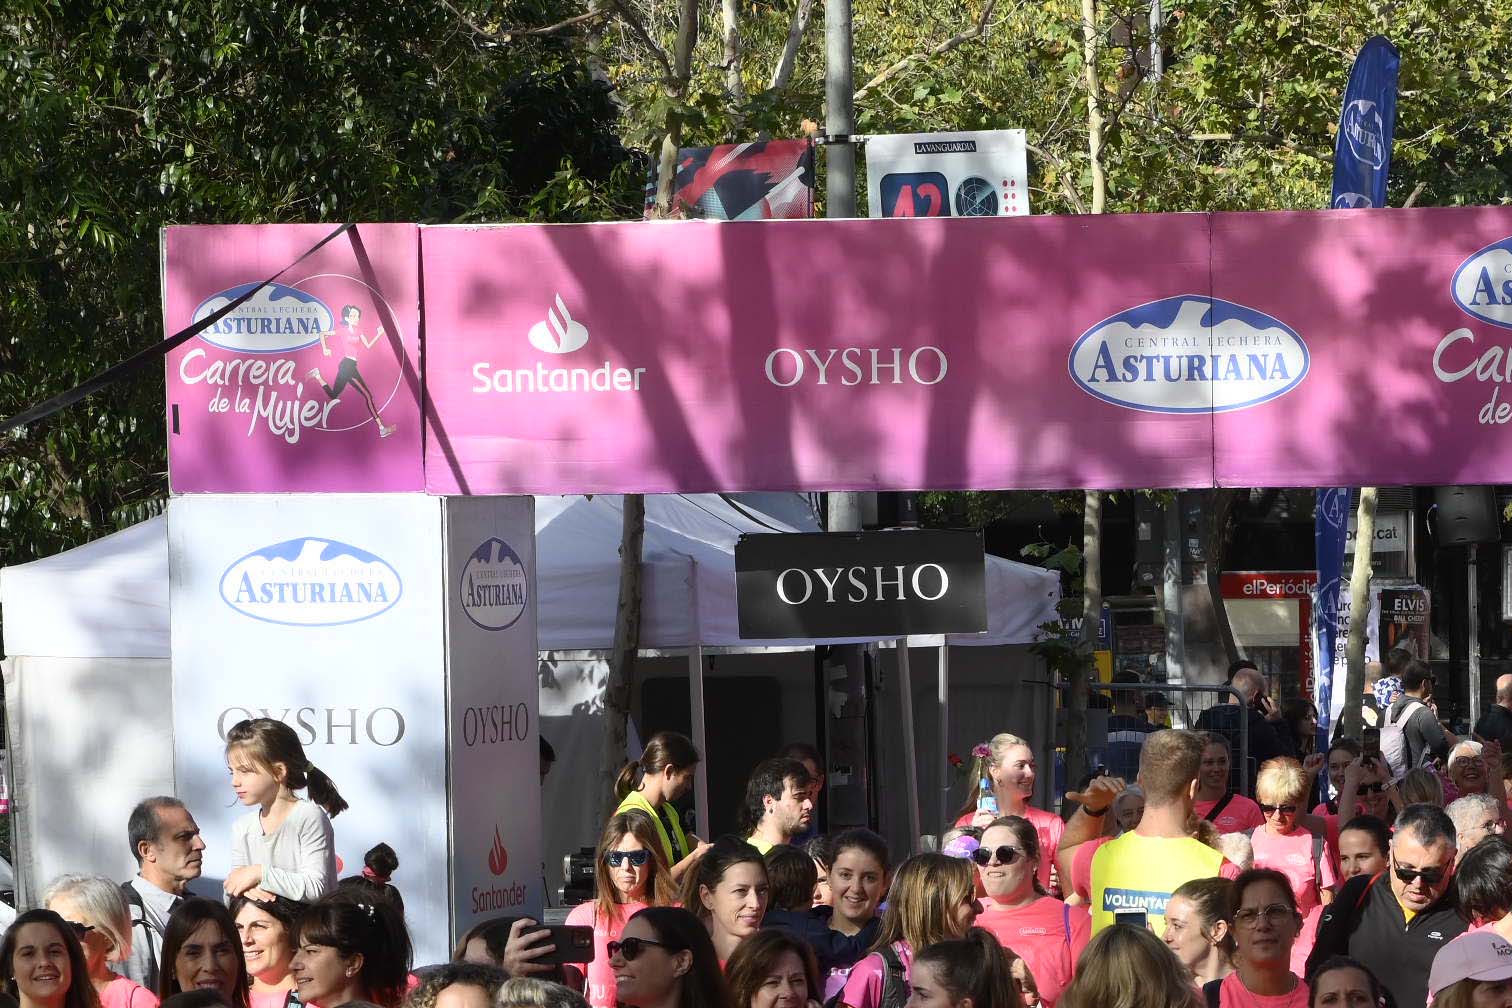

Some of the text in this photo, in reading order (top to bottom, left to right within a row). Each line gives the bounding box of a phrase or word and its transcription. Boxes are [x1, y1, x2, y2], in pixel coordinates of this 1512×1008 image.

[1124, 335, 1283, 348] CENTRAL LECHERA
[179, 348, 297, 385] Carrera
[473, 360, 646, 392] Santander
[765, 346, 948, 387] OYSHO
[1088, 340, 1291, 383] ASTURIANA
[208, 384, 342, 443] de la Mujer
[1478, 387, 1512, 425] de
[235, 571, 388, 603] ASTURIANA
[466, 573, 524, 608] ASTURIANA
[776, 564, 949, 605] OYSHO
[1394, 599, 1425, 611] ELVIS
[463, 702, 529, 747] OYSHO
[471, 881, 527, 914] Santander
